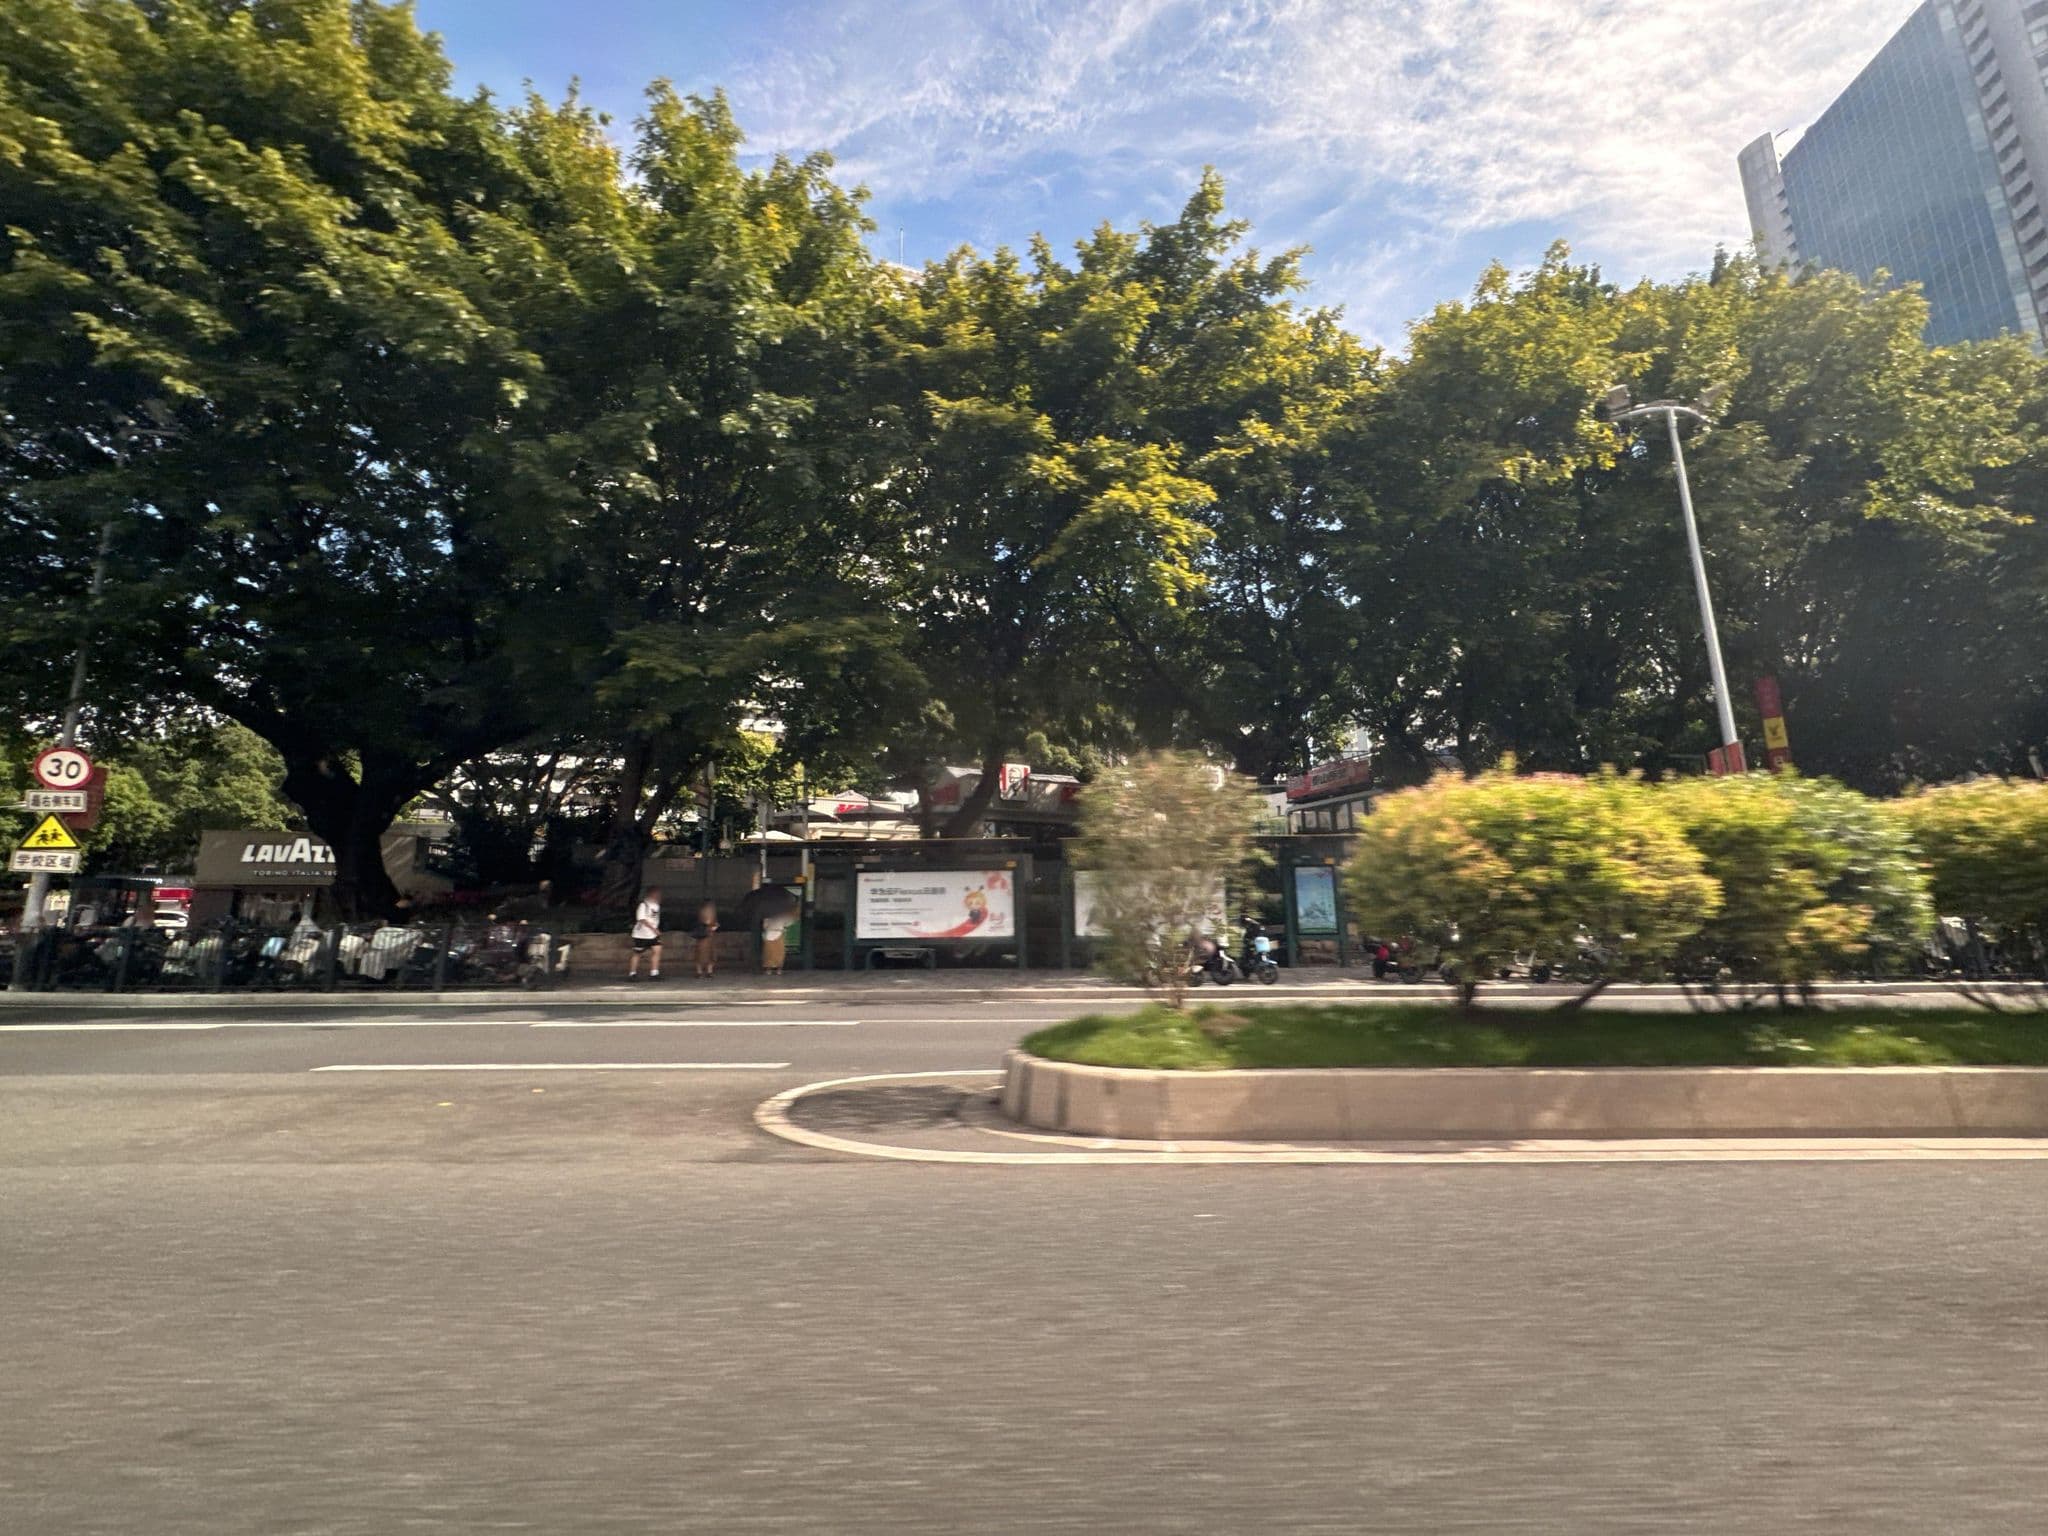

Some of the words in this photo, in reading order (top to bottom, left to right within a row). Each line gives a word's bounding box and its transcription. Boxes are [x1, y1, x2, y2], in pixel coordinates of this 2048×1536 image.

[47, 758, 81, 779] 30
[16, 853, 72, 868] 学校区域
